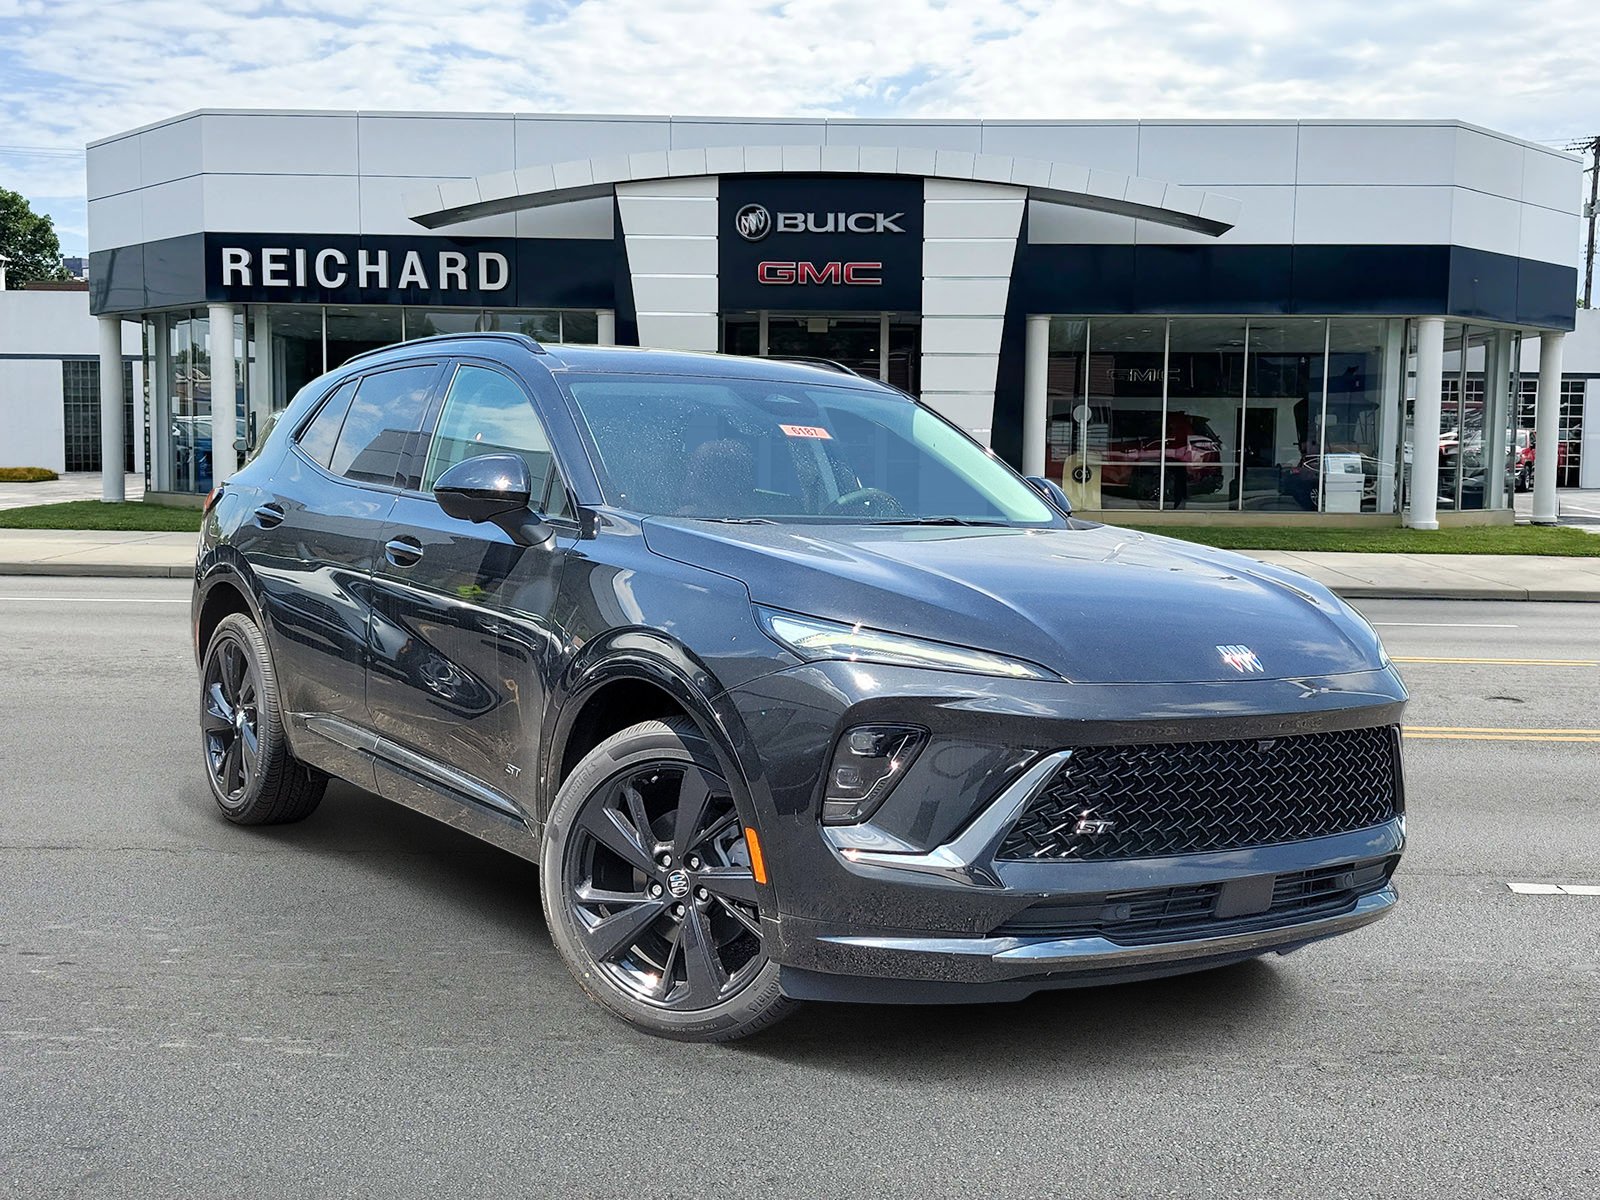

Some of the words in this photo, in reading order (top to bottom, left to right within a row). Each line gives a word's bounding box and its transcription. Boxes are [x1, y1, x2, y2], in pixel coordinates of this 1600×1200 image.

[776, 211, 907, 233] BUICK
[221, 247, 510, 291] REICHARD
[757, 261, 882, 285] GMC
[1106, 367, 1181, 382] GMC
[790, 426, 819, 437] 6187
[1075, 819, 1115, 834] ST
